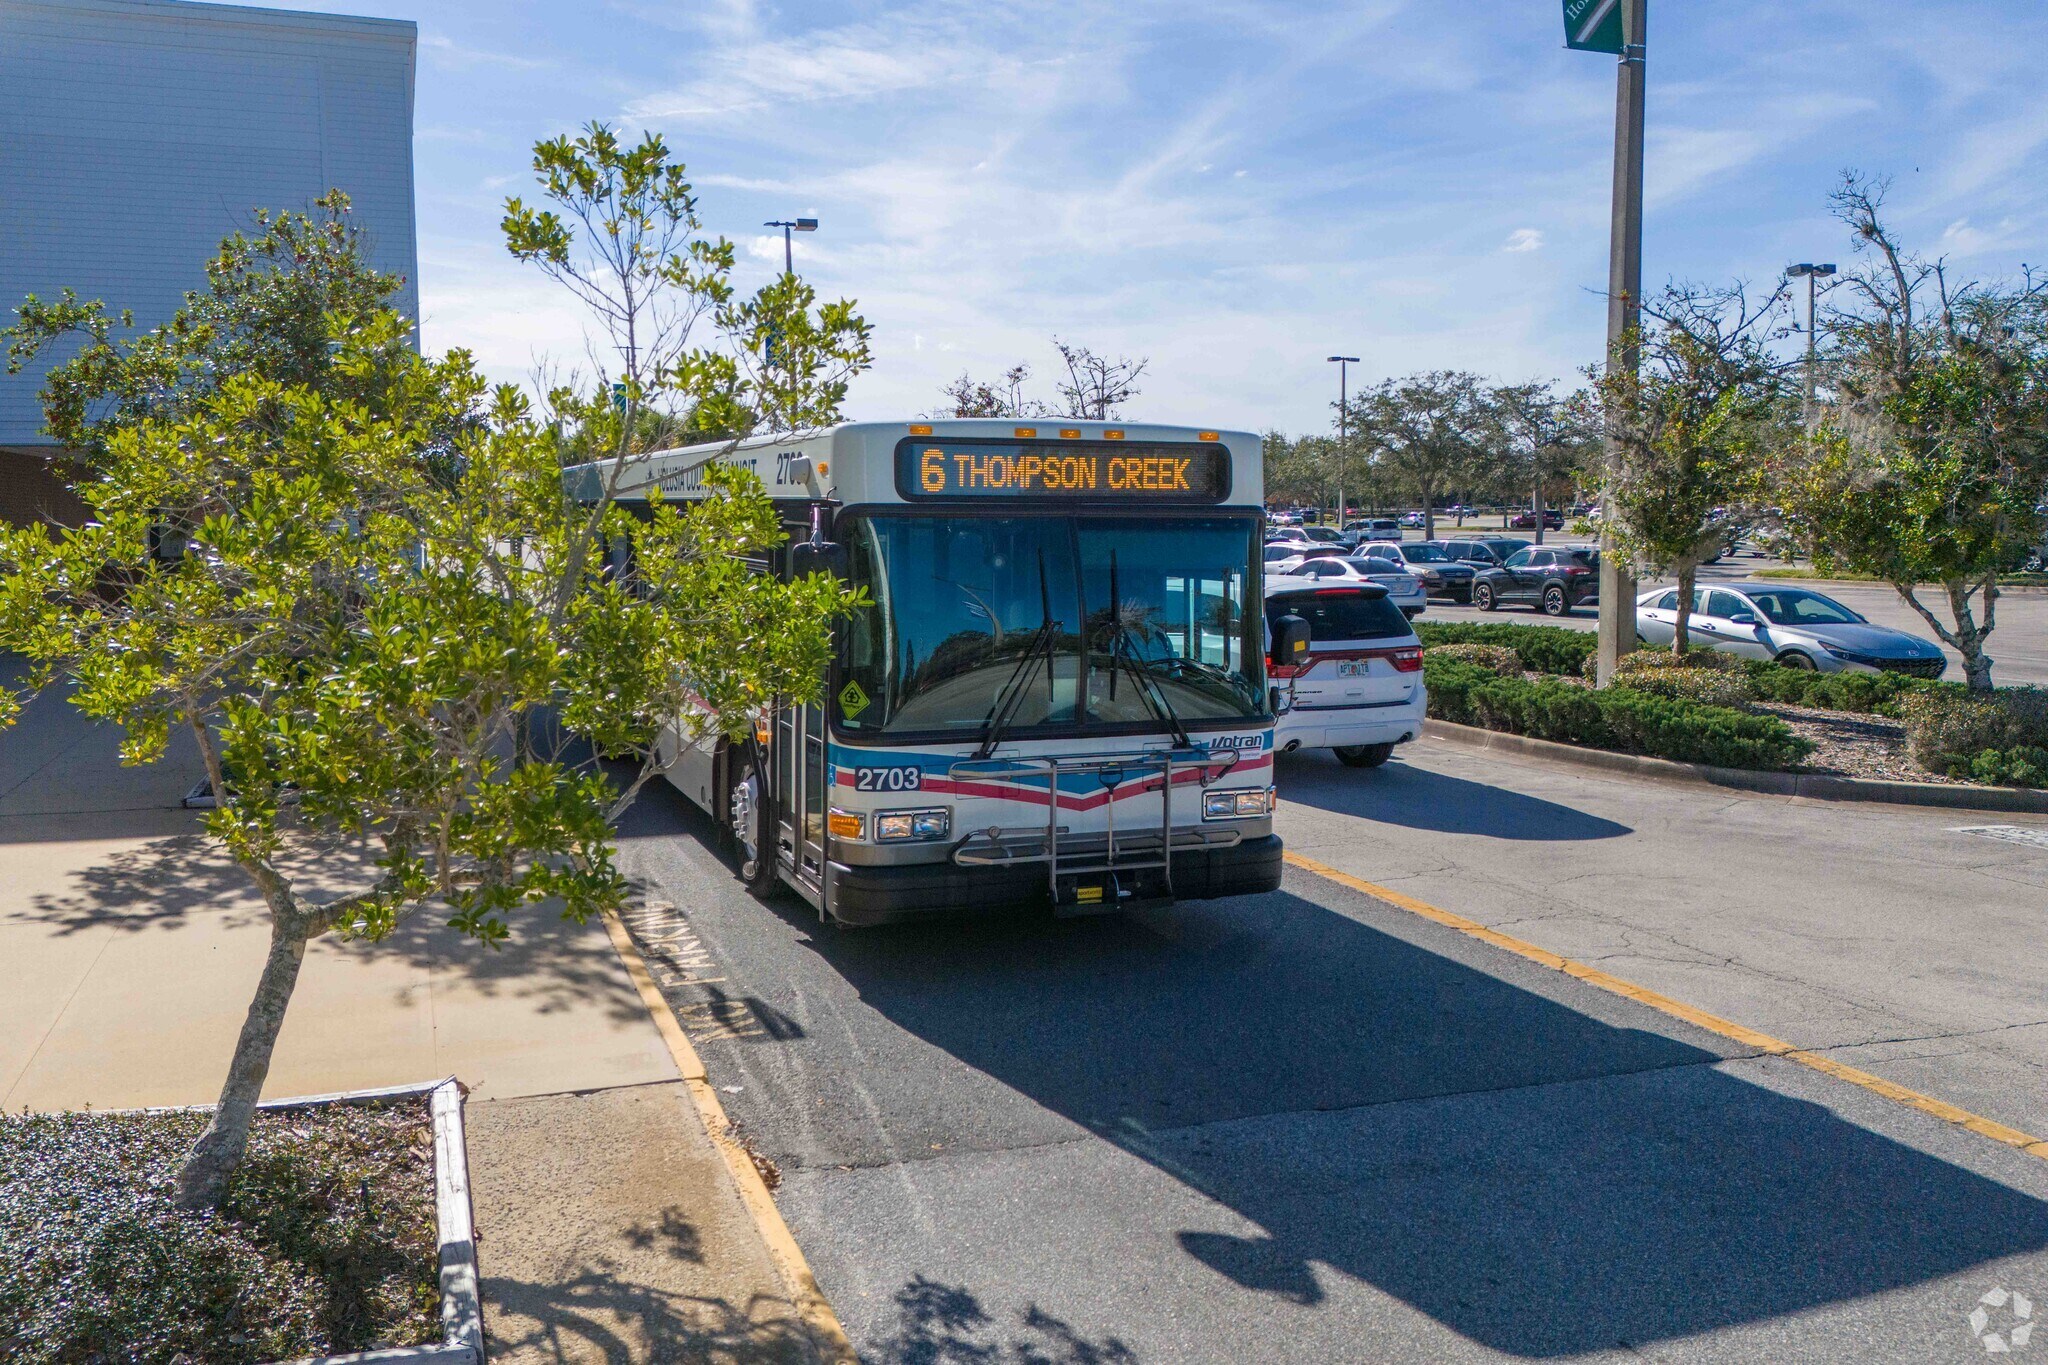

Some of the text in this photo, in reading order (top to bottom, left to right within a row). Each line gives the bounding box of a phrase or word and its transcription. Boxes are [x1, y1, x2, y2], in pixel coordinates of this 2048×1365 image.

[1566, 0, 1589, 20] Ho
[920, 448, 1191, 492] 6 THOMPSON CREEK
[1210, 735, 1262, 748] Votran
[857, 767, 919, 790] 2703
